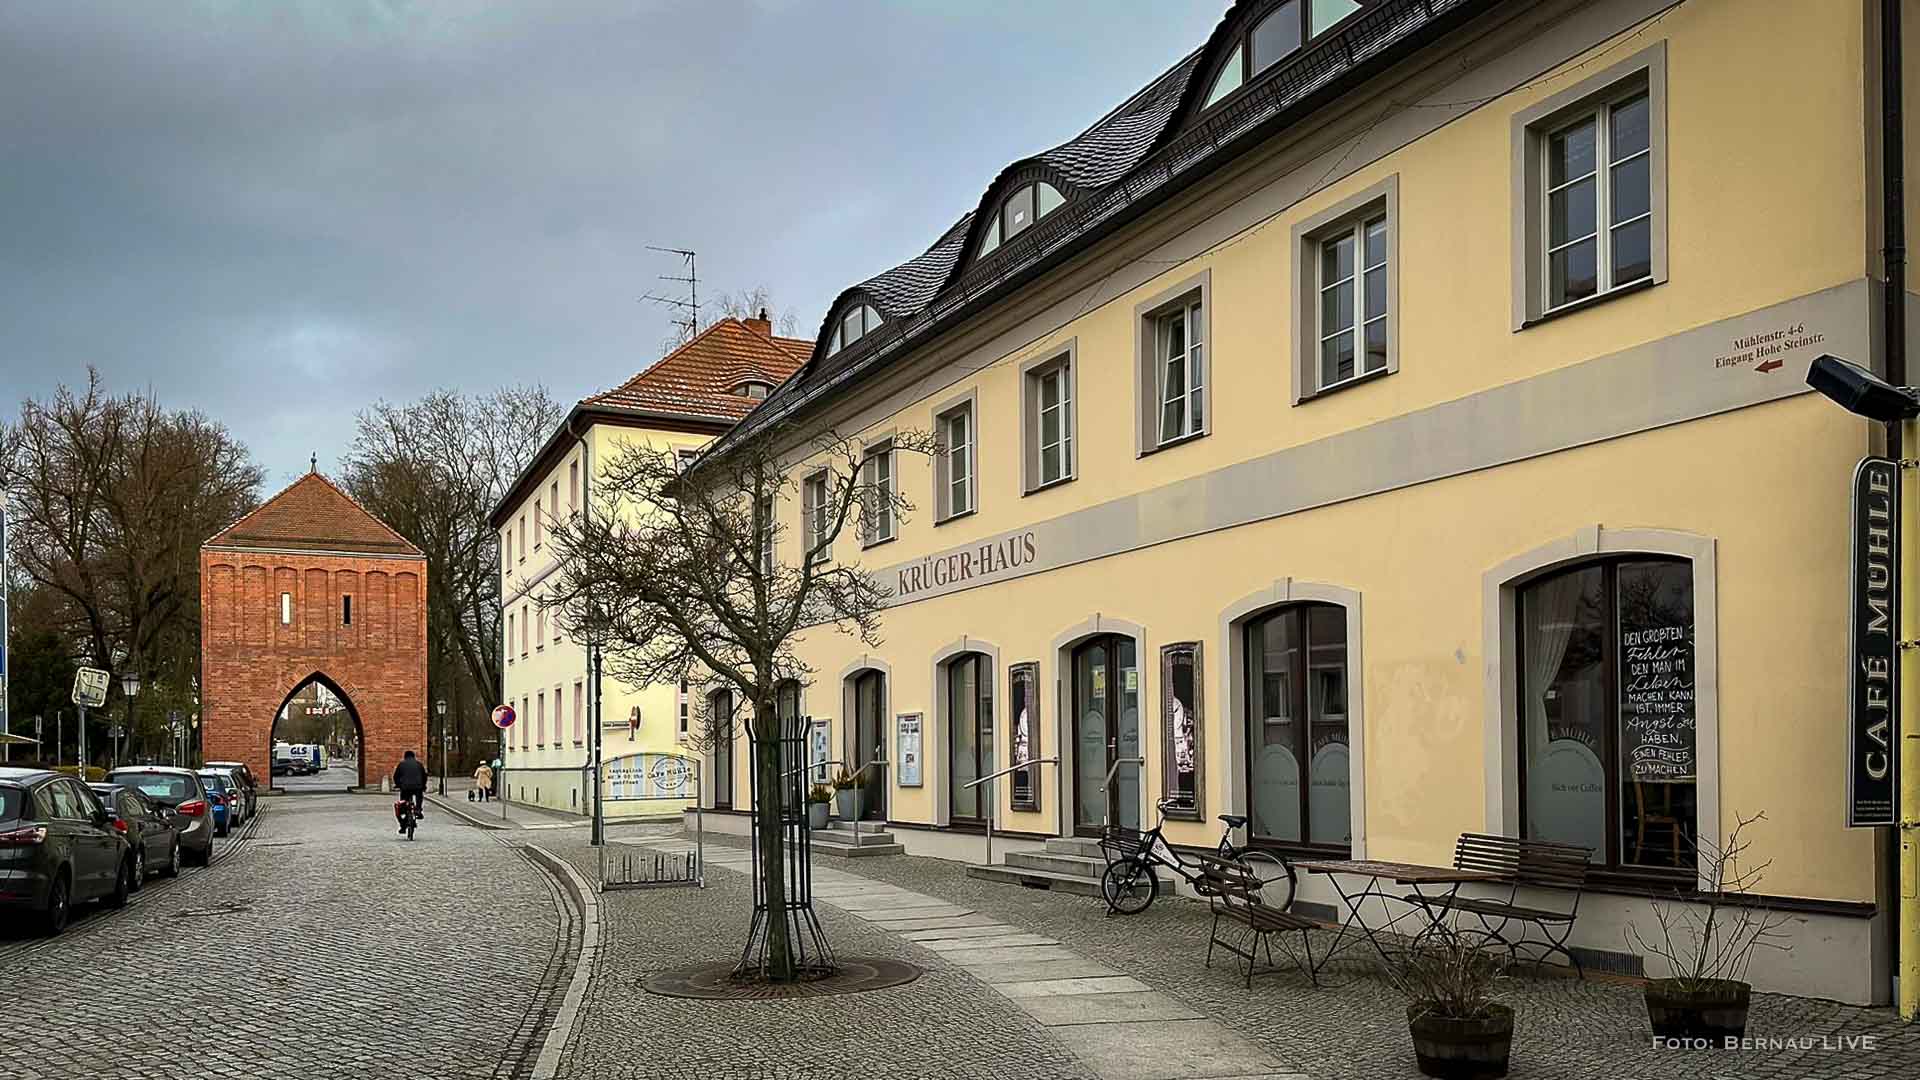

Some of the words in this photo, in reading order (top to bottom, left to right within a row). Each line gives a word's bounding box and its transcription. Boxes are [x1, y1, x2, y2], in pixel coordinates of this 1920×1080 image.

[1734, 330, 1785, 351] Mühlenstr.
[1788, 322, 1804, 336] 4-6
[1715, 352, 1754, 368] Eingang
[1756, 344, 1782, 358] Hohe
[1783, 334, 1825, 351] Steinstr.
[898, 531, 1036, 596] KRÜGER-HAUS
[1624, 632, 1641, 646] DEN
[1631, 663, 1649, 676] DEN
[1652, 660, 1672, 674] MAN
[1675, 658, 1686, 672] IM
[1626, 674, 1694, 692] Leben
[1628, 691, 1664, 704] MACHEN
[1668, 690, 1694, 701] KANN
[1654, 702, 1685, 713] IMMER
[1626, 714, 1675, 735] Angst
[1860, 655, 1889, 780] CAFÉ
[290, 746, 308, 755] GLS
[1658, 749, 1690, 762] FEHLER
[1635, 764, 1648, 775] ZU
[1648, 763, 1688, 775] MACHEN
